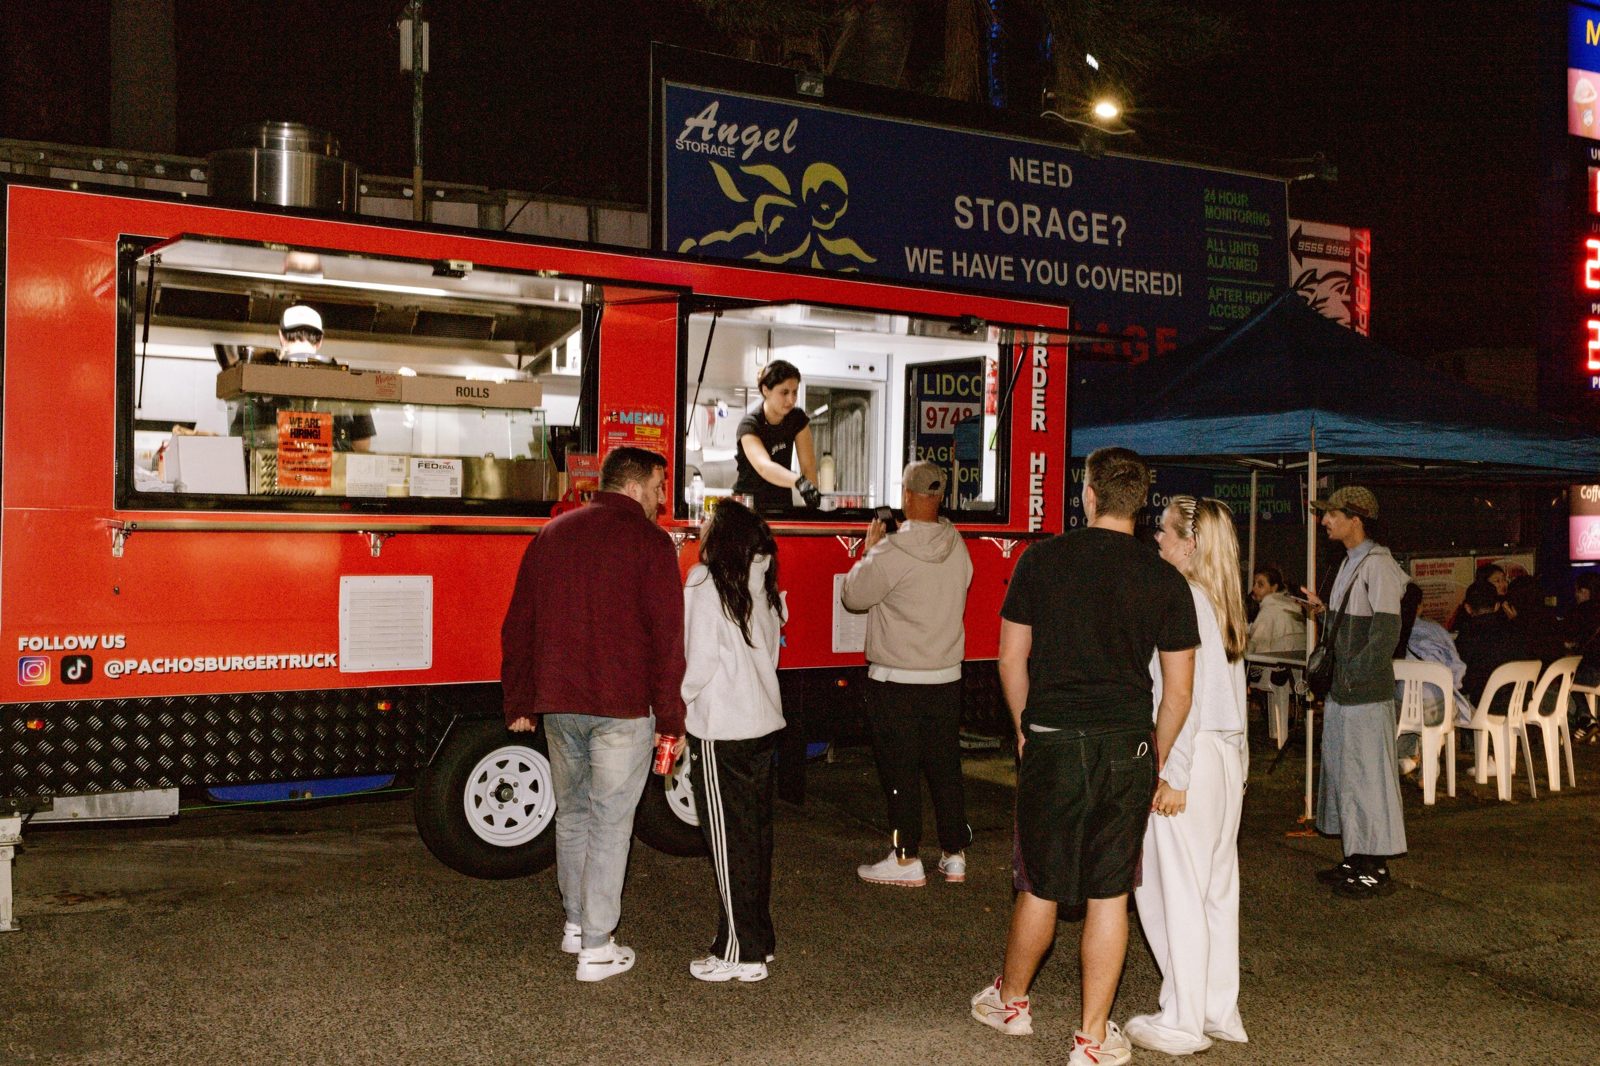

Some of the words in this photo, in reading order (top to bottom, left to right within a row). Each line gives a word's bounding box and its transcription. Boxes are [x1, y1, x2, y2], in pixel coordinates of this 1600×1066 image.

[679, 101, 798, 160] Angel
[675, 138, 736, 158] STORAGE
[1009, 156, 1073, 188] NEED
[1218, 189, 1249, 208] HOUR
[954, 195, 1127, 247] STORAGE?
[1204, 204, 1271, 227] MONITORING
[1206, 236, 1227, 253] ALL
[1228, 239, 1260, 257] UNITS
[904, 246, 944, 275] WE
[952, 251, 1014, 281] HAVE
[1021, 258, 1068, 287] YOU
[1075, 264, 1183, 297] COVERED!
[1207, 254, 1258, 273] ALARMED
[1207, 286, 1243, 303] AFTER
[1030, 332, 1048, 432] RDER
[455, 386, 490, 399] ROLLS
[289, 417, 302, 428] WE
[304, 418, 321, 429] ARE
[619, 411, 665, 426] MENU
[290, 428, 321, 439] HIRING!
[1028, 452, 1046, 533] HERE
[17, 635, 99, 651] FOLLOW
[101, 634, 127, 650] US
[103, 652, 338, 679] @PACHOSBURGERTRUCK
